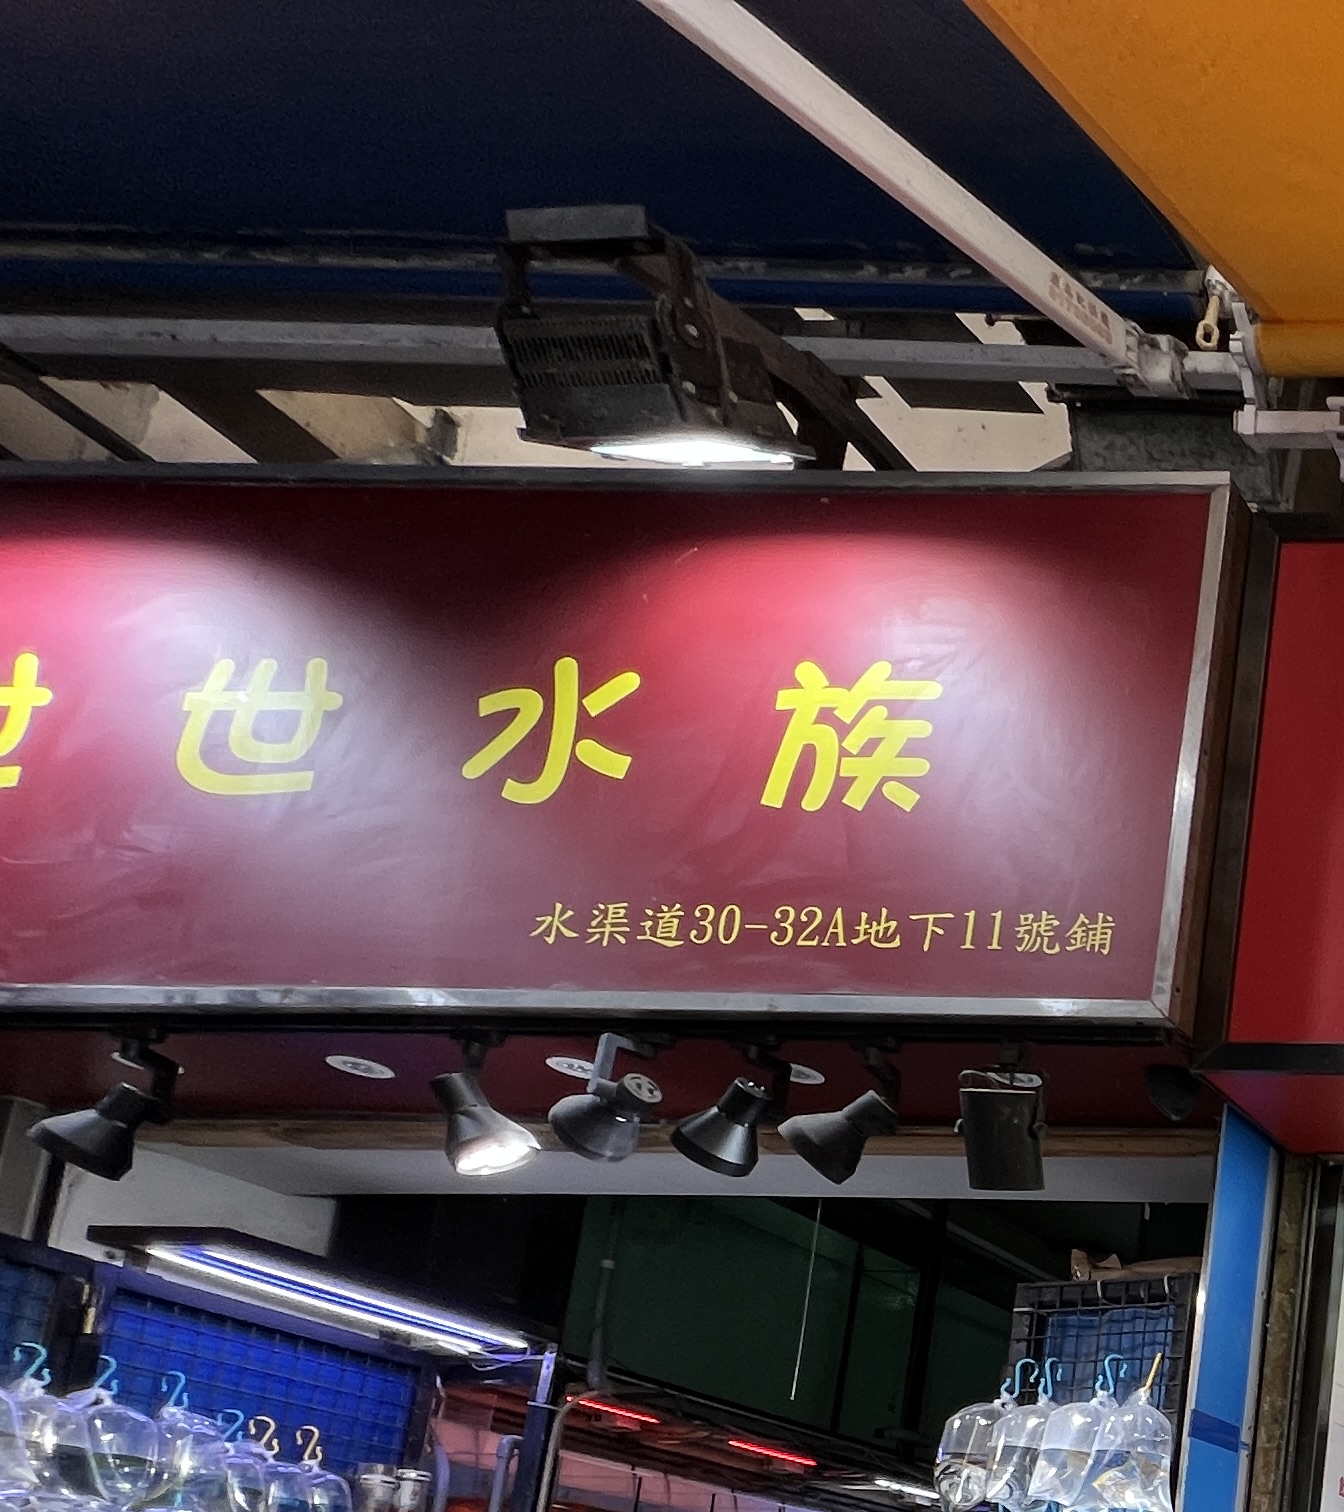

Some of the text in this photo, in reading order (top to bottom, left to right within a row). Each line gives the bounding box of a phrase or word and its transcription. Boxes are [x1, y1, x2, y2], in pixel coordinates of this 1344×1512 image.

[528, 902, 1116, 955] 水渠道30-32A地下11號鋪
